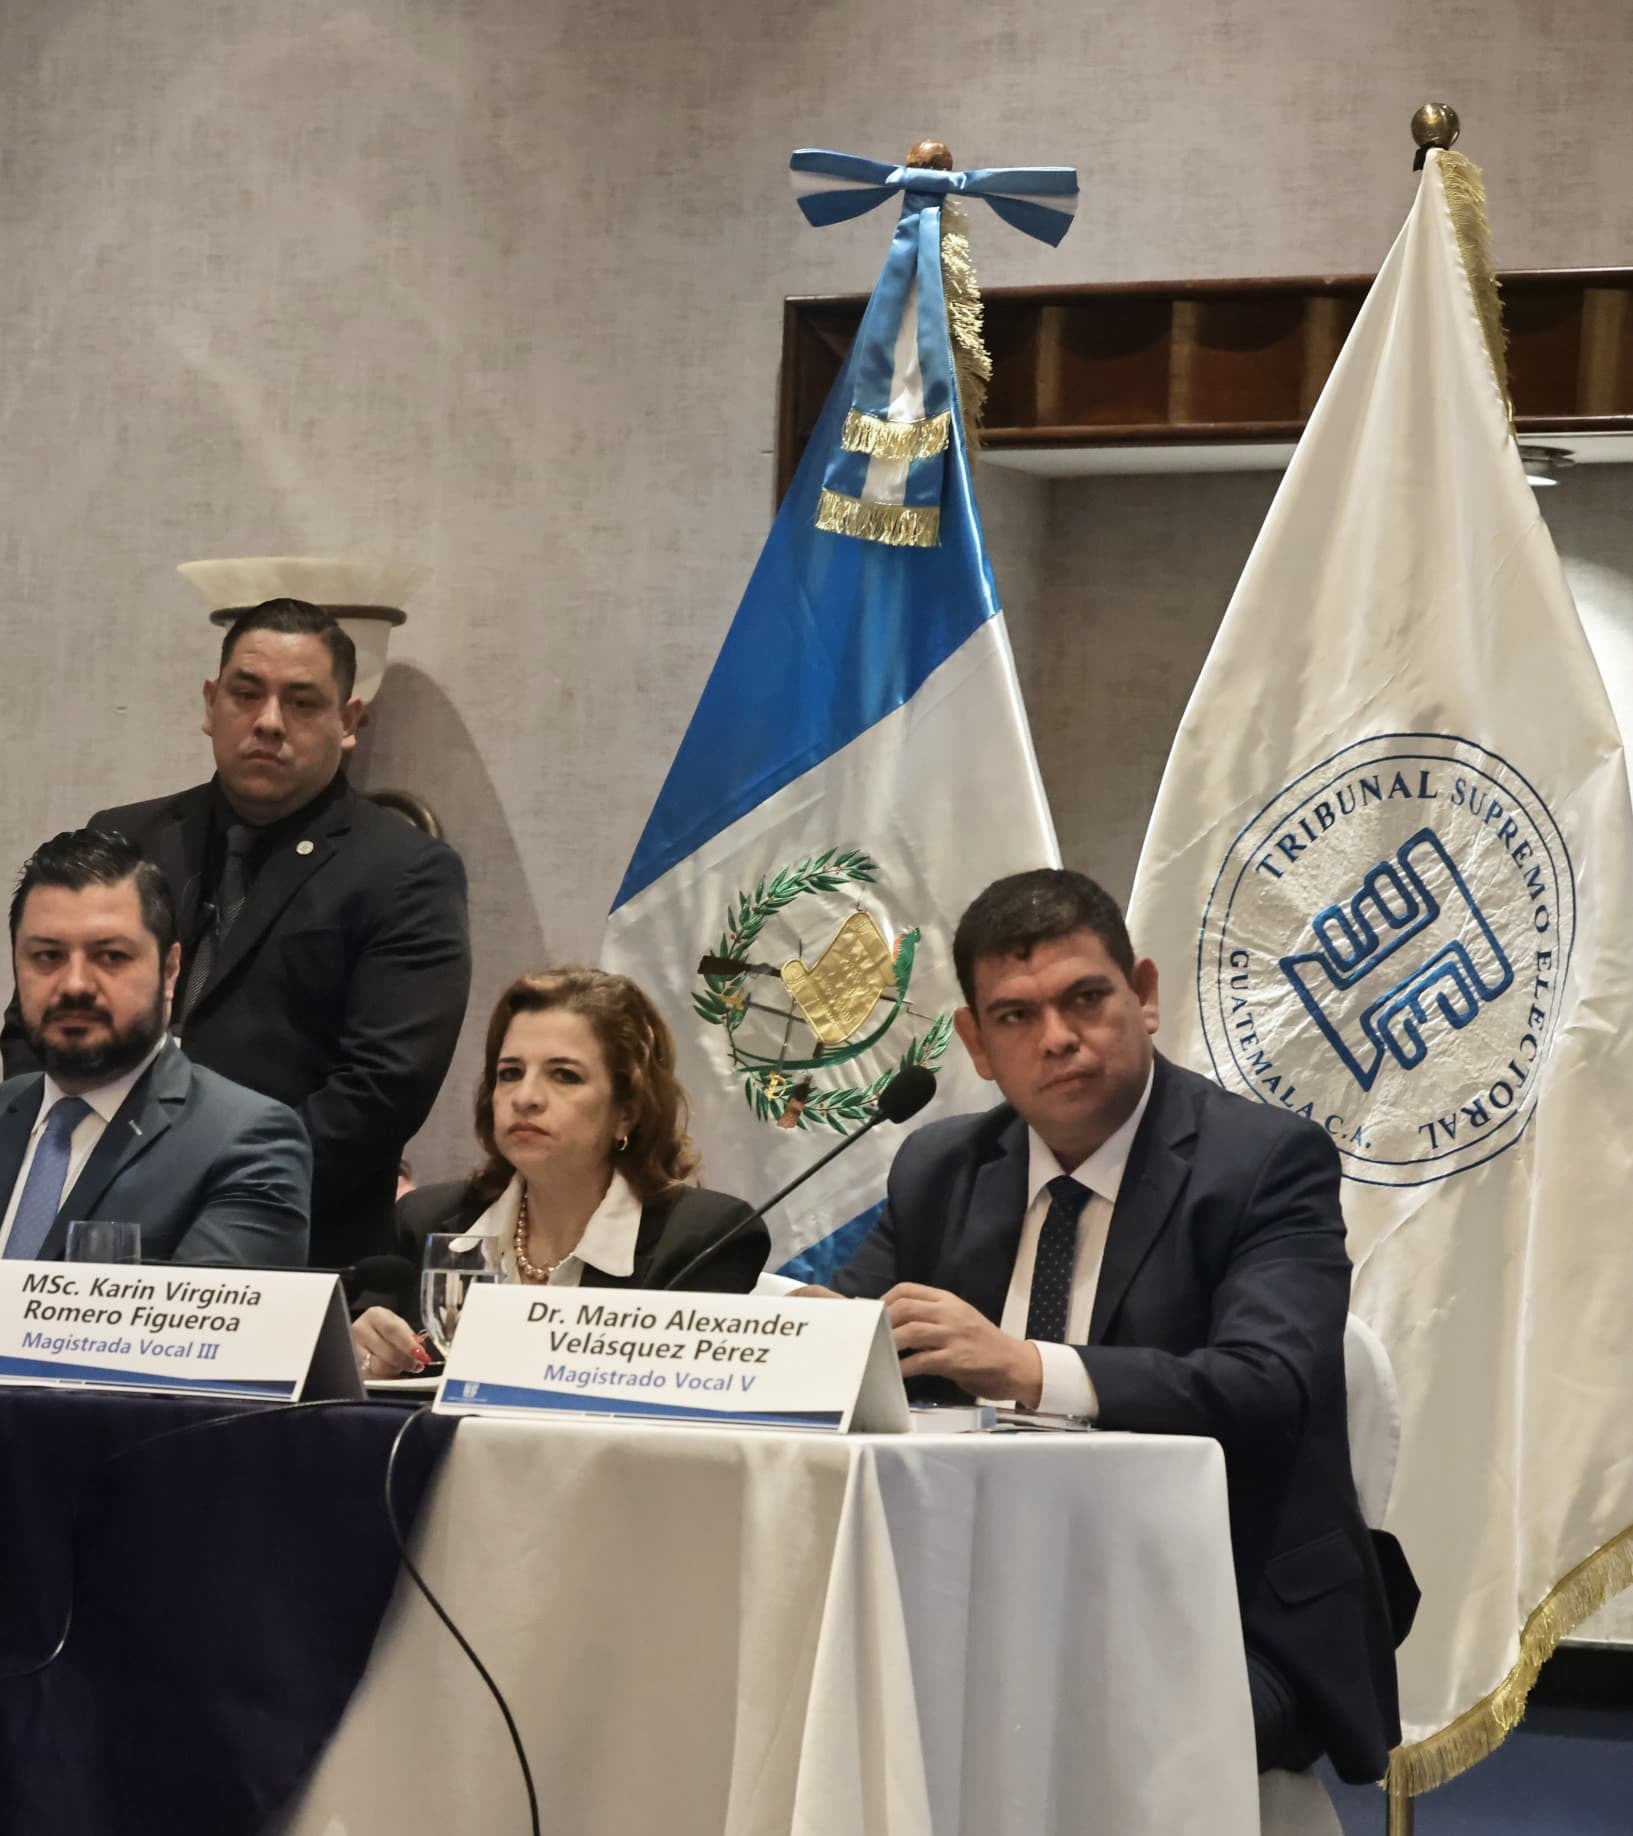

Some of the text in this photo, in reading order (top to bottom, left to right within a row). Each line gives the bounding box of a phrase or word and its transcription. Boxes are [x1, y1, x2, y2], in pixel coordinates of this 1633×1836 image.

[1255, 771, 1552, 1150] TRIBUNAL SUPREMO ELECTORAL
[1230, 950, 1314, 1120] GUATEMALA
[21, 1273, 262, 1310] MSc. Karin Virginia
[23, 1299, 241, 1334] Romero Figueroa
[527, 1301, 809, 1337] Dr. Mario Alexander
[21, 1331, 221, 1360] Magistrada Vocal III
[550, 1330, 771, 1364] Velásquez Pérez
[543, 1363, 758, 1392] Magistrado Vocal V
